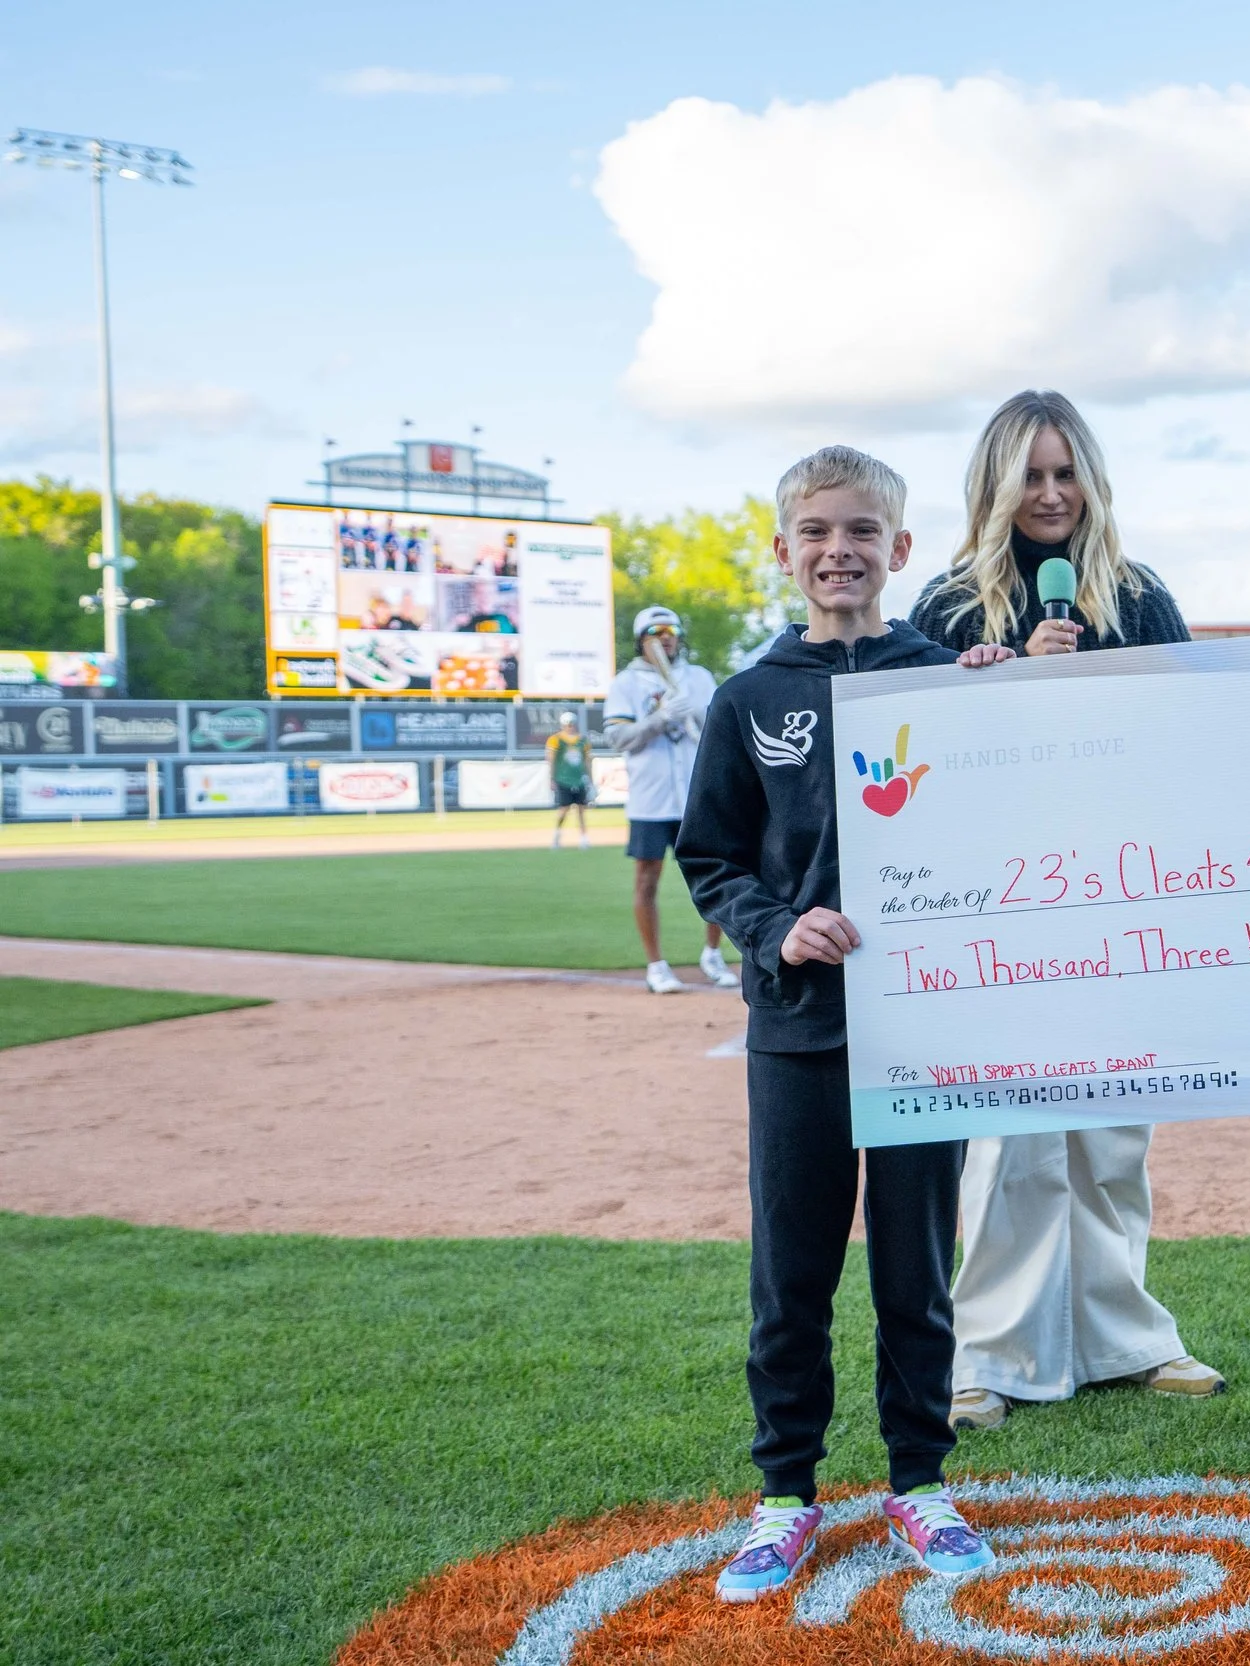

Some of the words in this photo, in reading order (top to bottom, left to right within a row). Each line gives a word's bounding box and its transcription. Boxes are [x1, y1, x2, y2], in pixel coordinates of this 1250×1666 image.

[944, 748, 1021, 770] HANDS
[1031, 744, 1058, 762] OF
[879, 866, 915, 889] Pay
[918, 866, 933, 880] to
[1000, 849, 1104, 906] 23's
[1119, 842, 1236, 900] Cleats
[881, 896, 906, 914] the
[910, 891, 961, 913] Order
[964, 888, 992, 913] Of
[887, 946, 958, 994] Two
[1123, 927, 1235, 973] Three
[887, 1065, 920, 1083] For
[927, 1064, 978, 1087] YOUTH
[984, 1063, 1037, 1080] SPORTS
[1044, 1061, 1097, 1078] CLEATS
[1106, 1053, 1157, 1073] GRANT
